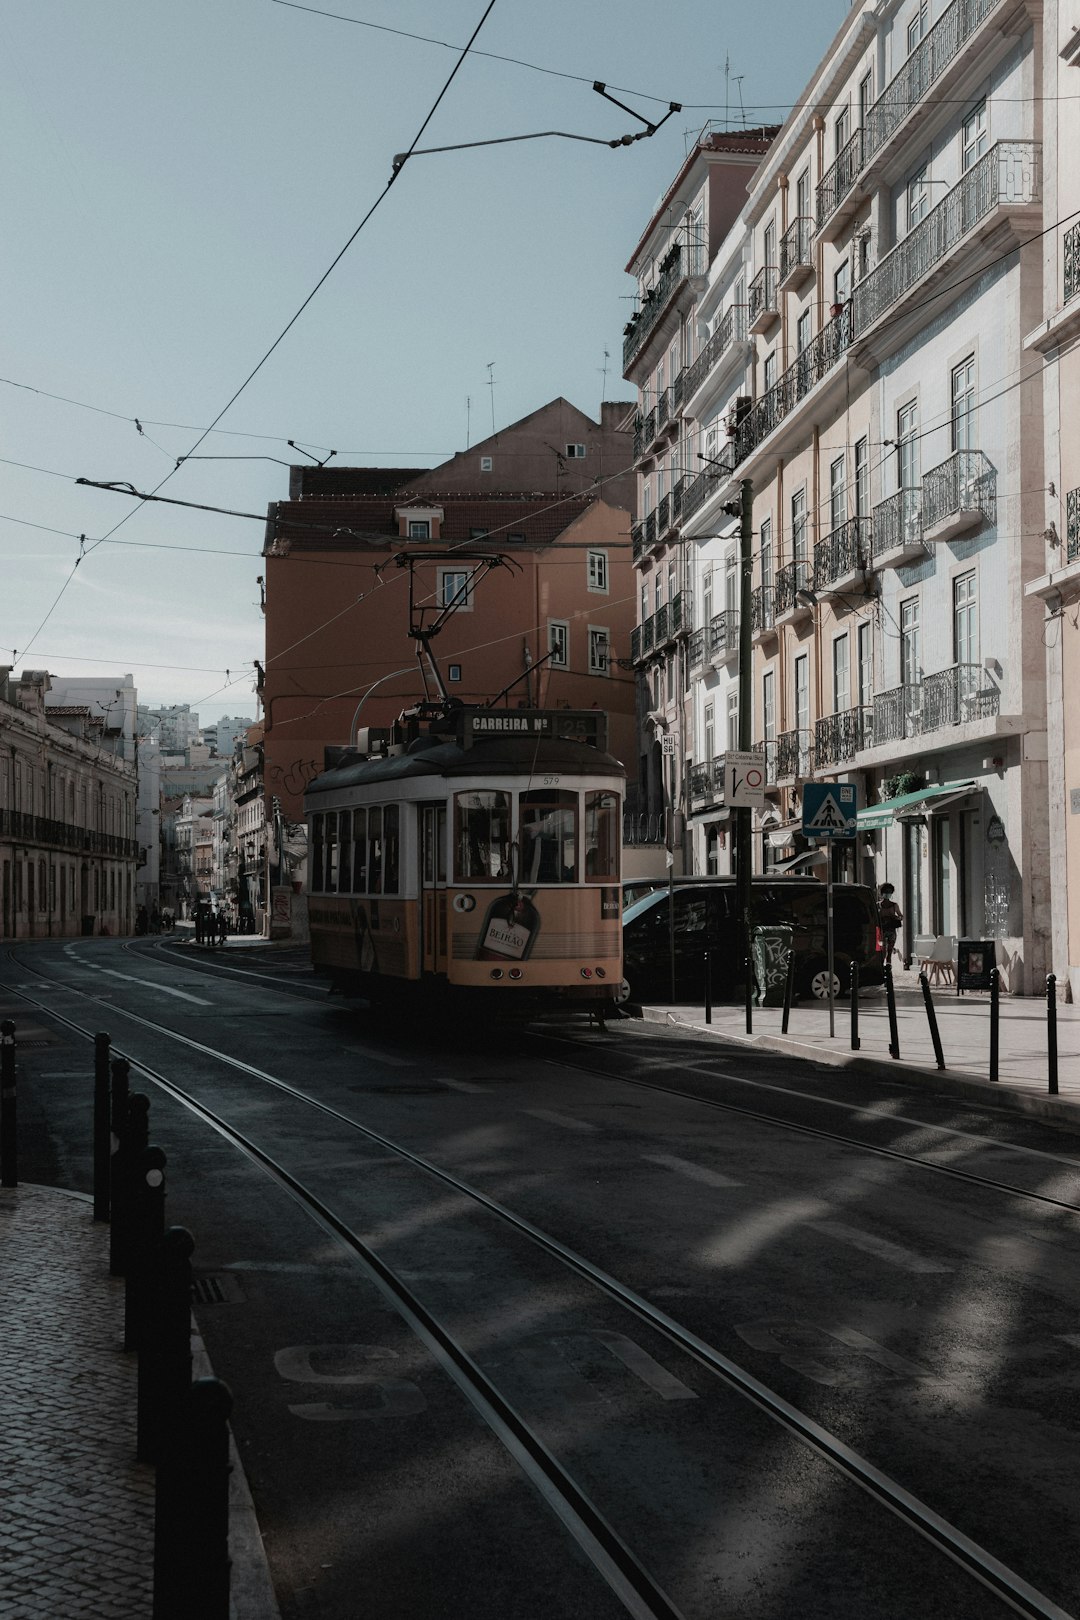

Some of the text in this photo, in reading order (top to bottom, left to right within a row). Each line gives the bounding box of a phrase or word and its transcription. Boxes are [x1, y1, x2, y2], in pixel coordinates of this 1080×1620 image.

[472, 717, 587, 734] CARREIRA Nº 25
[543, 777, 560, 786] 579
[489, 928, 524, 947] BEIRÃO
